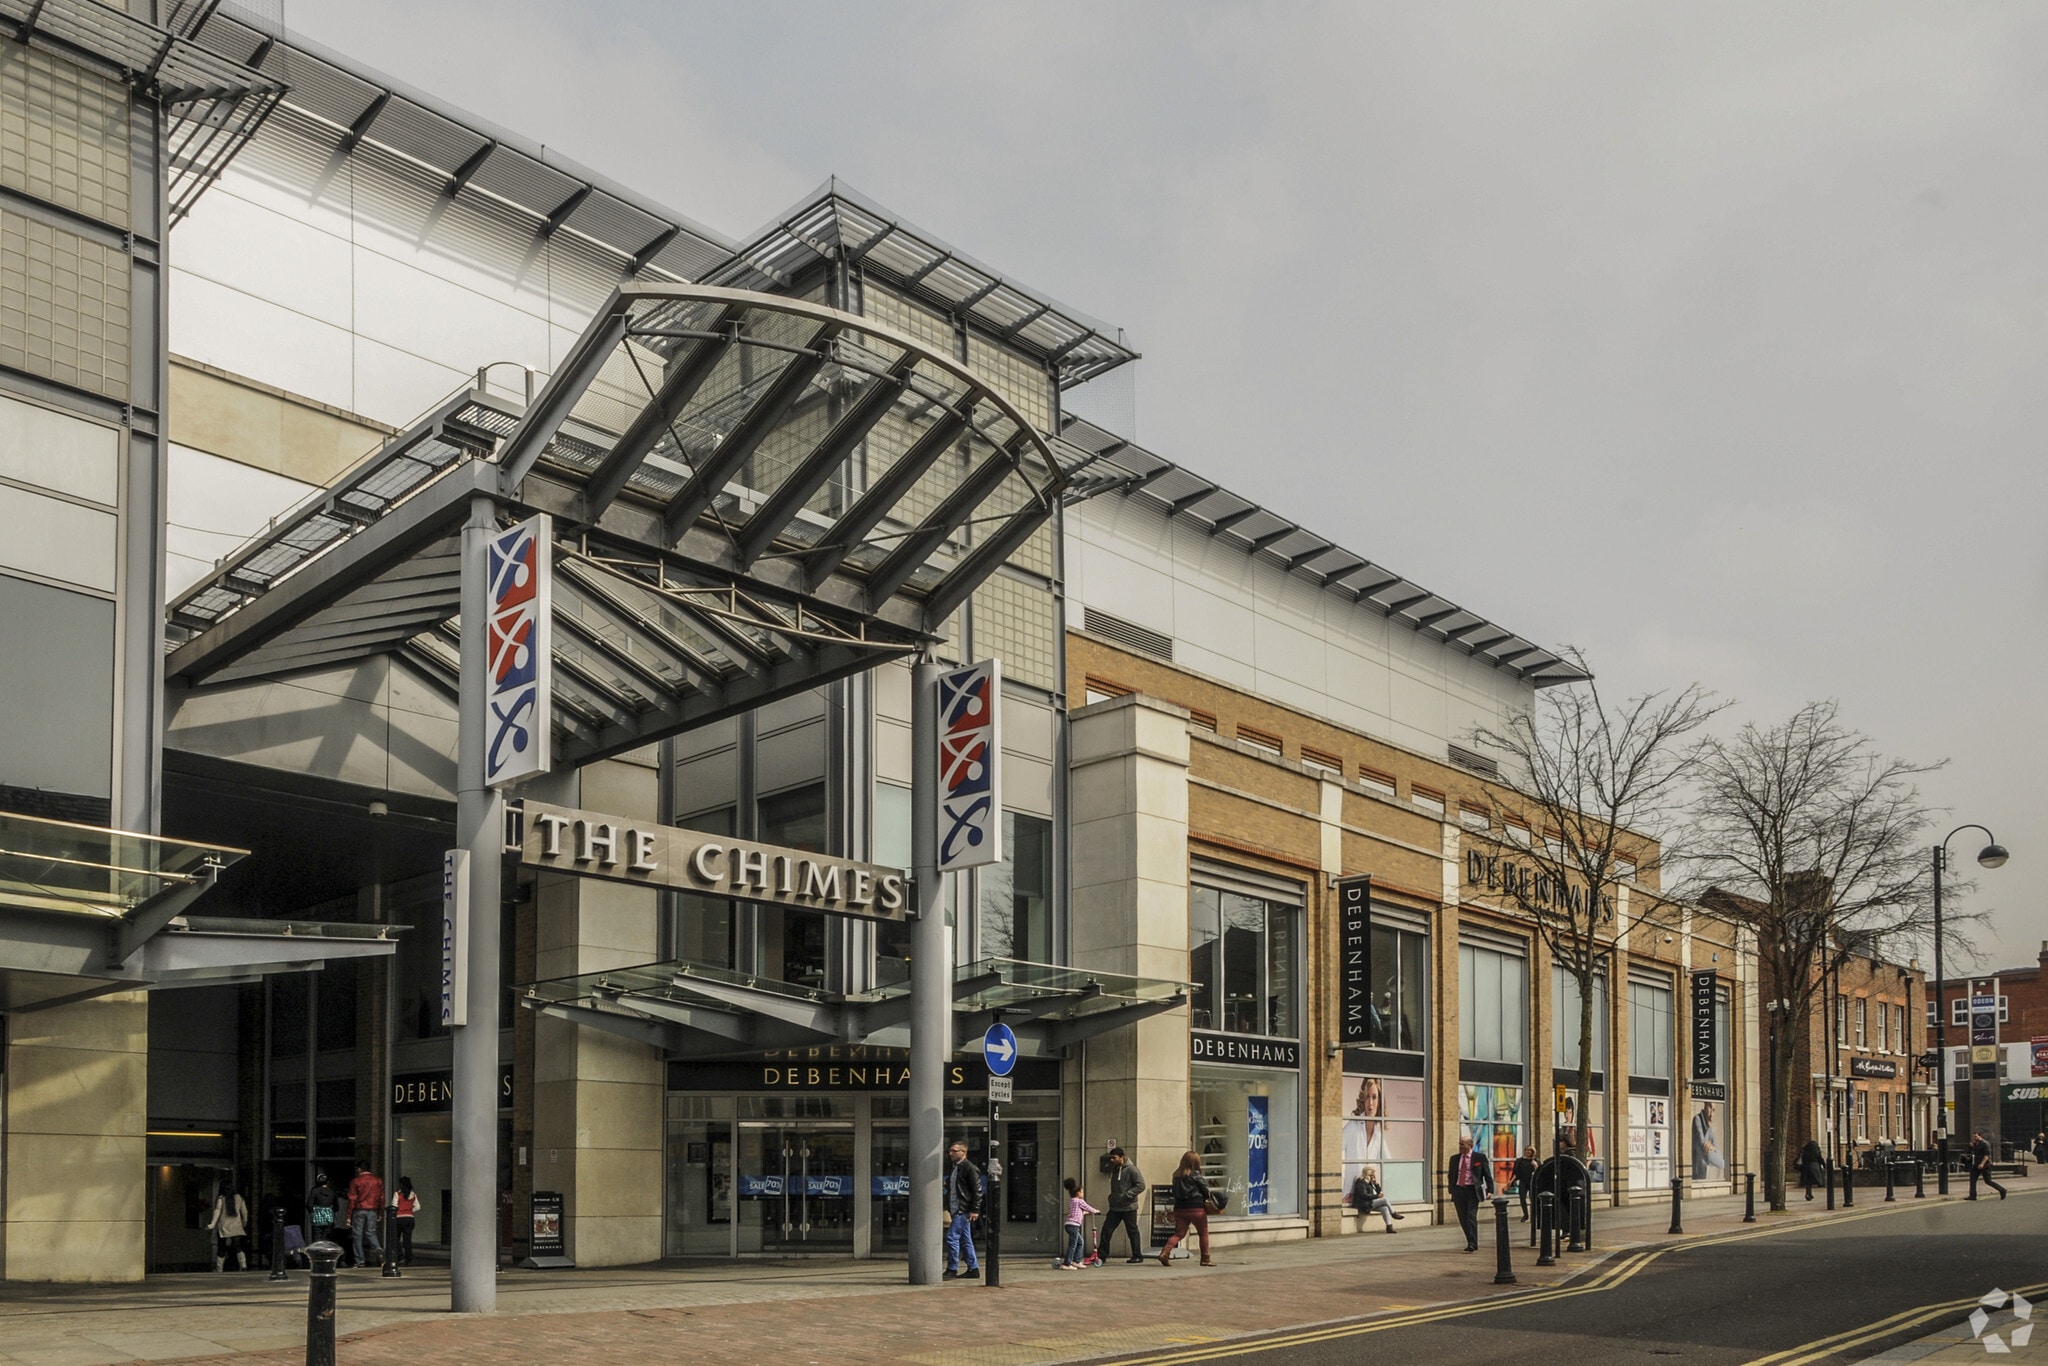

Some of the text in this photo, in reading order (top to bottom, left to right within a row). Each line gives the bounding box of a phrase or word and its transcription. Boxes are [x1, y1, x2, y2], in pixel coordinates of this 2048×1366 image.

[535, 812, 904, 911] THE CHIMES
[442, 918, 452, 1020] CHIMES
[1347, 888, 1362, 1035] DEBENHAMS
[1698, 976, 1710, 1074] DEBENHAMS
[1193, 1038, 1295, 1063] DEBENHAMS
[763, 1067, 965, 1085] DEBENHAS
[990, 1080, 1011, 1090] Except
[395, 1075, 512, 1103] DEBENS
[990, 1091, 1010, 1099] cycles
[1691, 1085, 1724, 1098] EBENHAMS
[749, 1182, 766, 1190] SALE
[808, 1182, 824, 1190] SALE
[882, 1182, 899, 1190] SALE
[1226, 1172, 1272, 1195] Life made
